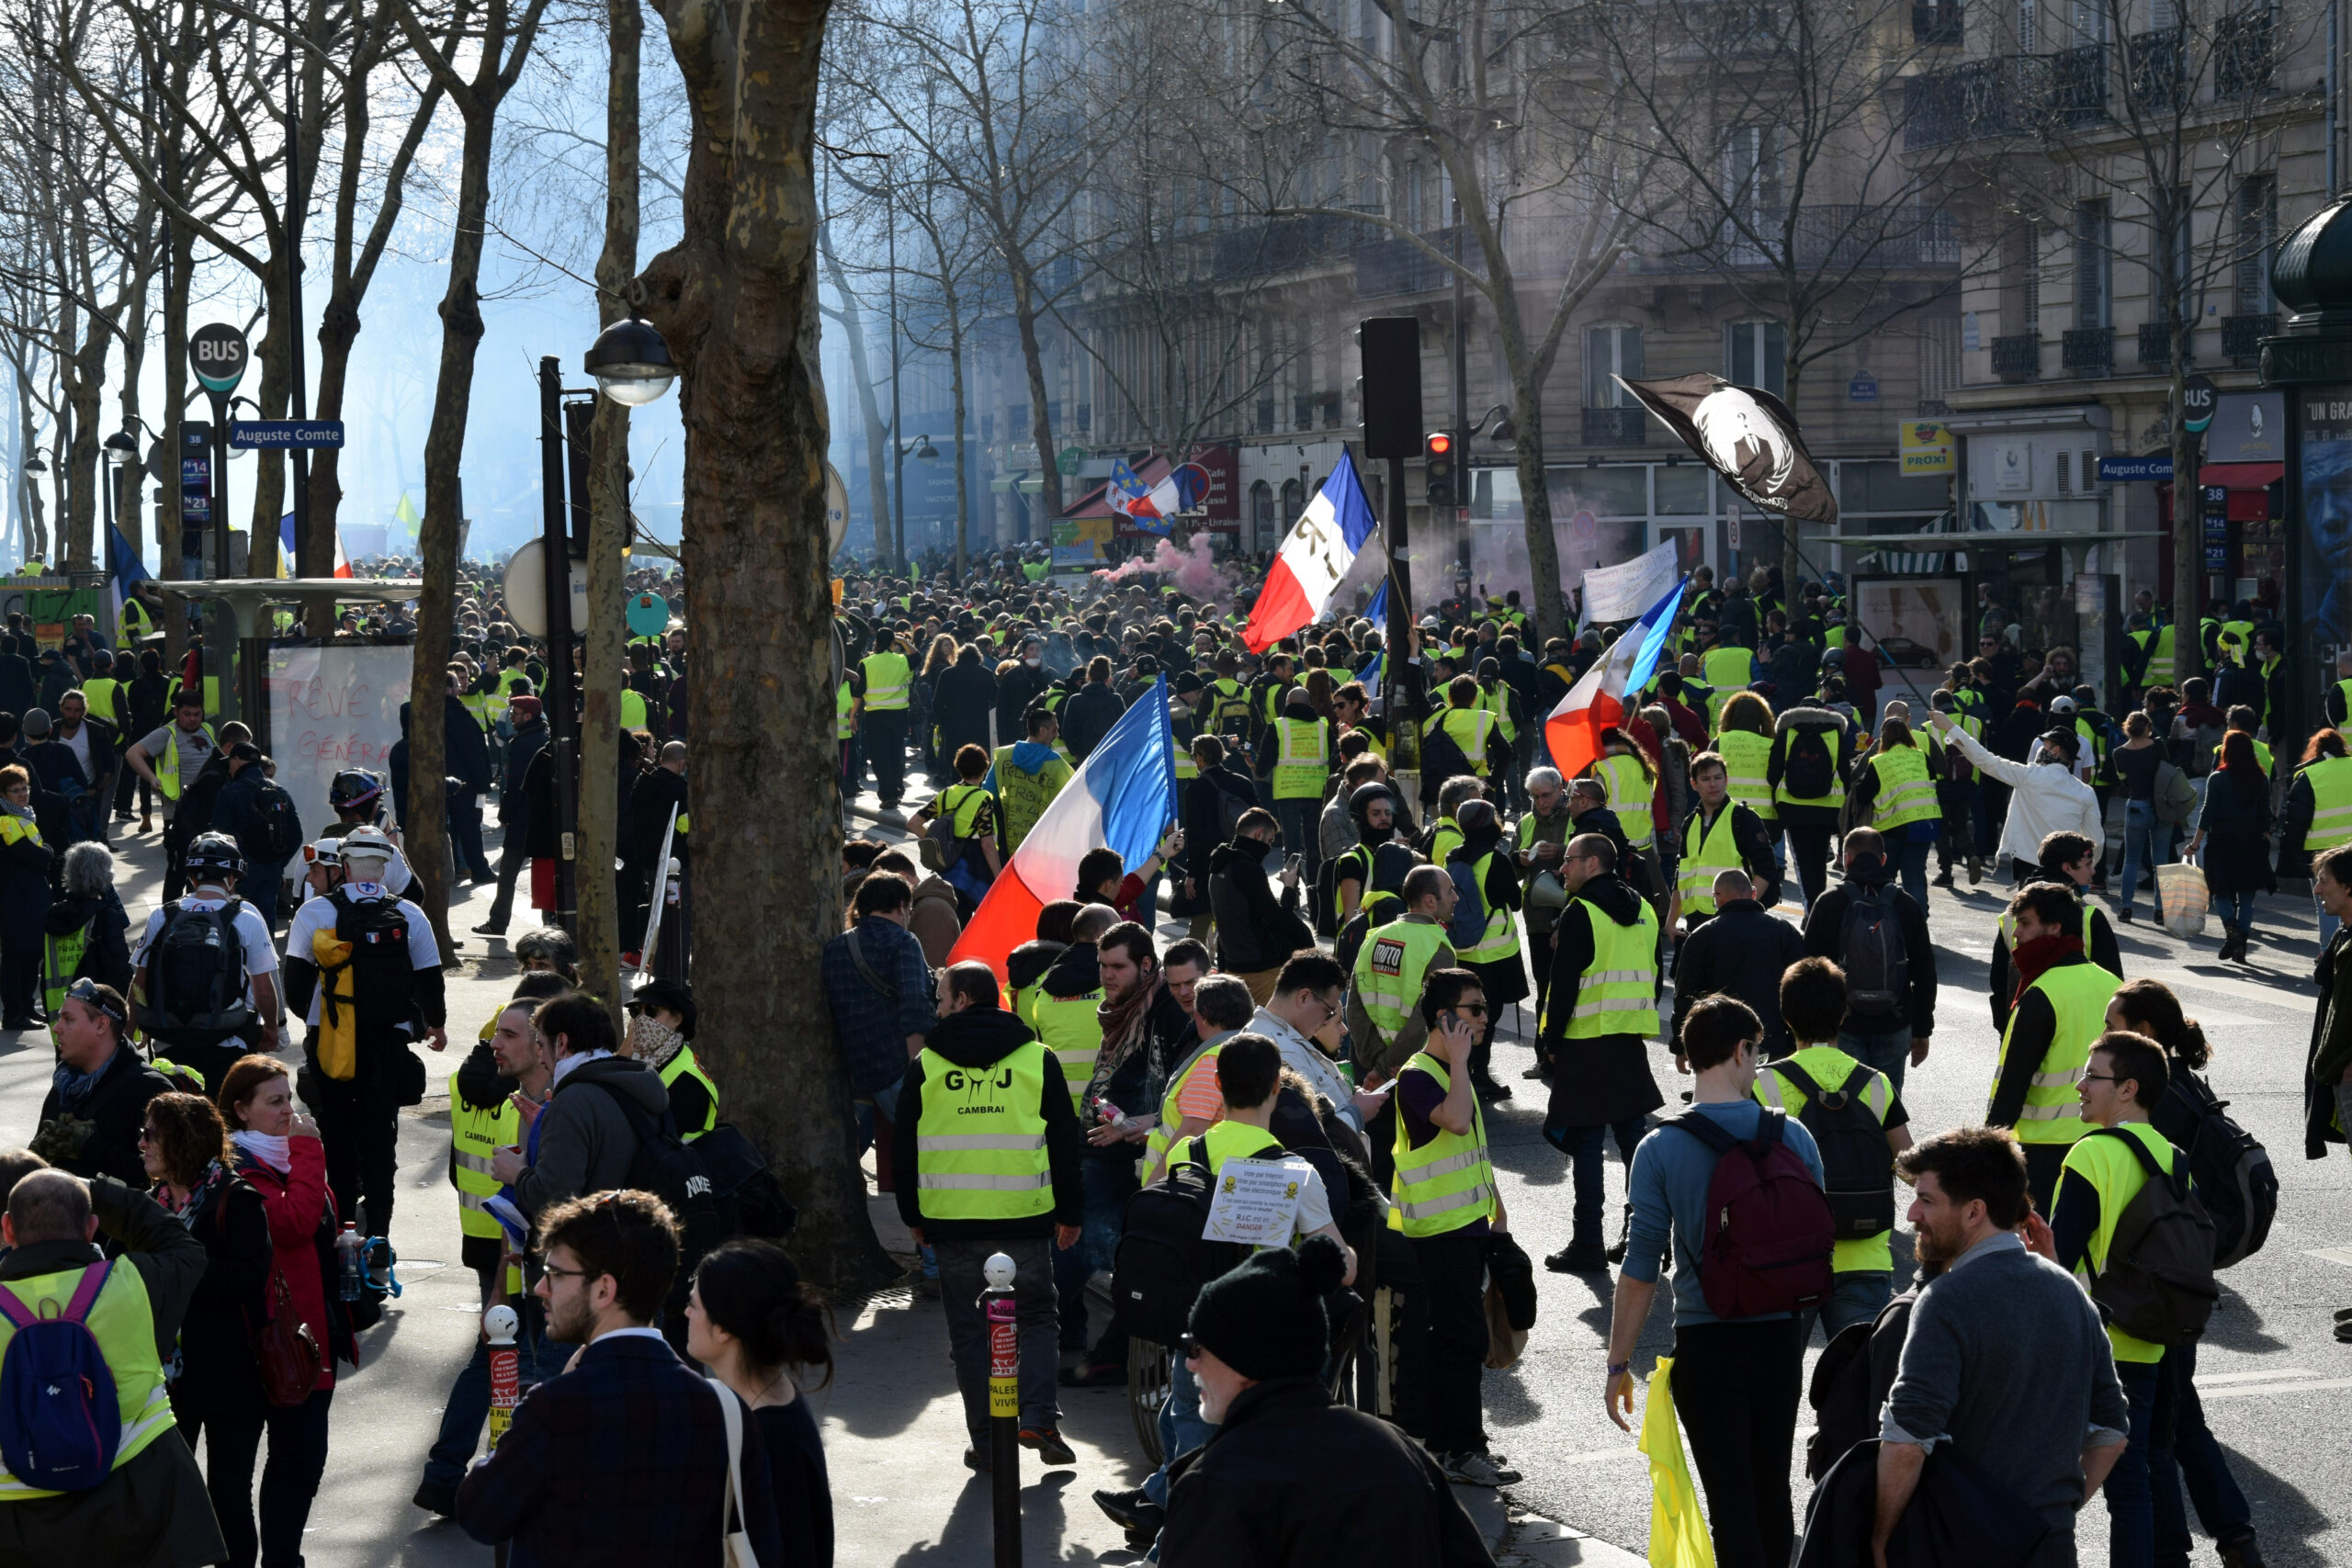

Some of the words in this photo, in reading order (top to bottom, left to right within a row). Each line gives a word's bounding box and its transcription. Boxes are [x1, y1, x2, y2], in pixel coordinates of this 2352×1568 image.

[198, 340, 240, 361] BUS
[2185, 389, 2211, 406] BUS
[190, 435, 201, 444] 38
[236, 429, 291, 444] Auguste
[295, 428, 339, 441] Comte
[1907, 453, 1946, 466] PROXI
[2102, 463, 2146, 477] Auguste
[2208, 488, 2223, 501] 38
[288, 676, 369, 721] RÊVE
[1374, 944, 1401, 966] MOTO
[957, 1106, 1004, 1114] CAMBRAI
[465, 1131, 495, 1145] CAMBRAI
[685, 1175, 712, 1199] NIKE
[1236, 1213, 1251, 1222] R.I.C.
